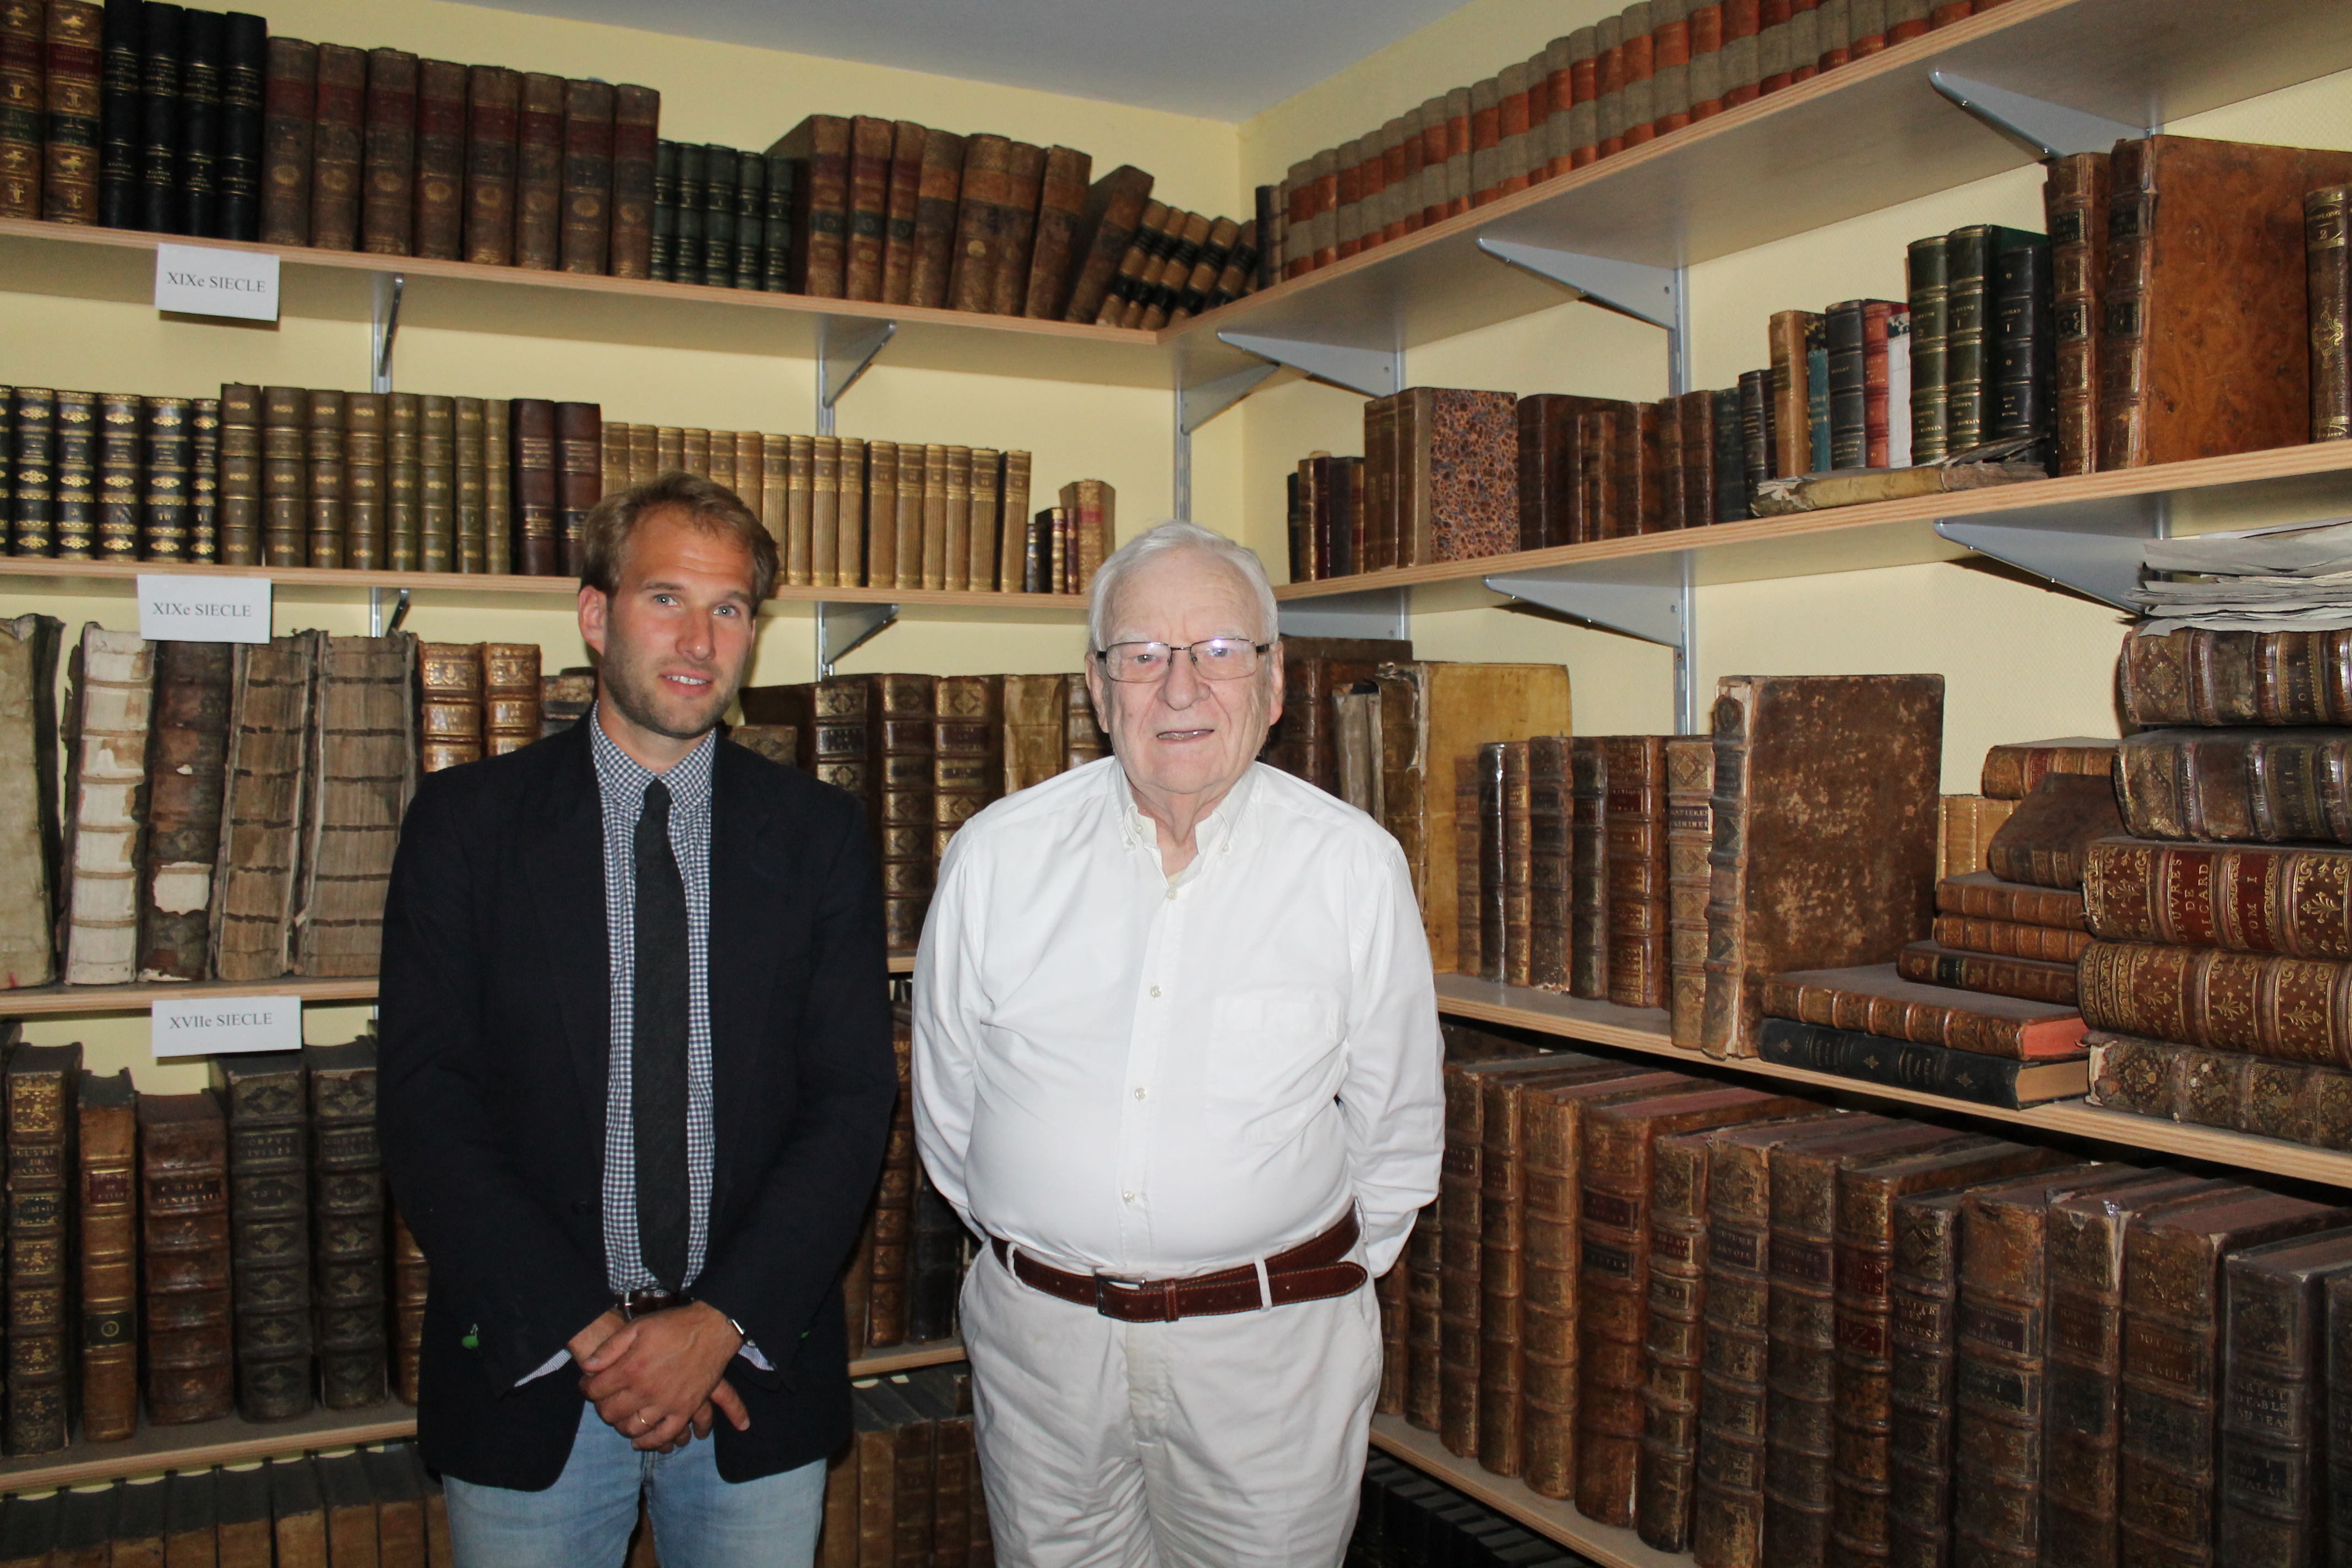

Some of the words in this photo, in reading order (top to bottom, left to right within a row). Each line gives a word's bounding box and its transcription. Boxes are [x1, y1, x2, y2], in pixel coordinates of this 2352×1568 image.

[2318, 230, 2328, 240] 2
[167, 271, 205, 287] XIXe
[209, 275, 266, 293] SIECLE
[153, 603, 191, 616] XIXe
[195, 605, 252, 617] SIECLE
[2171, 858, 2188, 942] OEUVRES
[2184, 889, 2196, 912] DE
[2197, 863, 2214, 938] RICARD
[169, 1016, 213, 1030] XVIIe
[217, 1012, 274, 1027] SIECLE
[1901, 1308, 1921, 1321] DES
